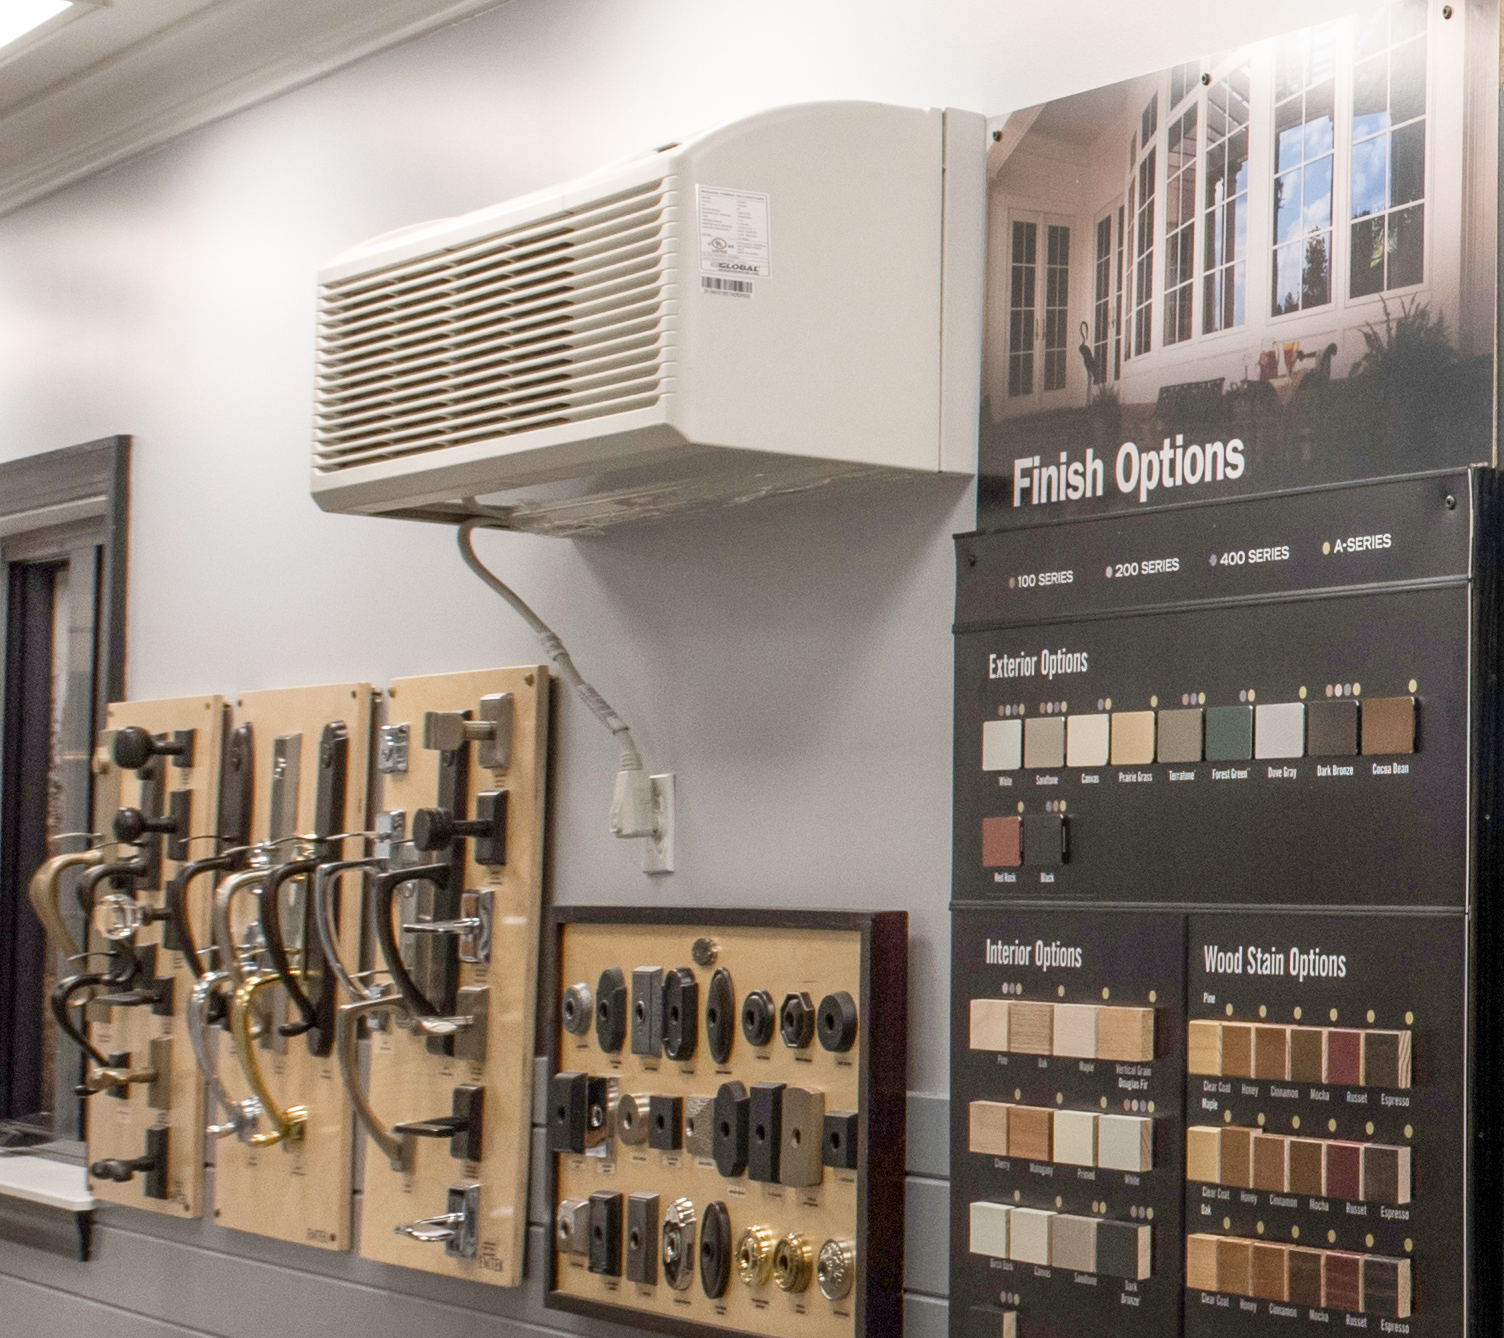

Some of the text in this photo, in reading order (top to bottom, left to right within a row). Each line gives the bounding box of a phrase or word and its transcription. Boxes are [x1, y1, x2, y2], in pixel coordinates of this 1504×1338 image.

[1014, 434, 1245, 507] Finish Options
[1220, 546, 1289, 565] 400 SERIES
[1115, 558, 1179, 577] 200 SERIES
[1018, 570, 1073, 587] 100 SERIES
[989, 648, 1088, 679] Exterior Options
[1212, 769, 1230, 779] Forest
[1317, 765, 1353, 776] Dark Bronze
[1372, 763, 1409, 775] Cocoa Bean
[1119, 771, 1152, 782] Prairie Grass
[986, 939, 1082, 972] Interior Options
[1204, 945, 1346, 982] Wood Stain Options
[1203, 992, 1215, 1004] Pine
[1203, 1080, 1231, 1093] Clear Coat
[1242, 1084, 1258, 1097] Honey
[1271, 1086, 1298, 1098] Cinnamon
[1310, 1089, 1330, 1101] Mocha
[1346, 1091, 1367, 1103] Russet
[1381, 1093, 1410, 1107] Espresso
[1202, 1098, 1218, 1111] Maple
[1346, 1202, 1367, 1215] Russet
[1381, 1206, 1409, 1220] Espresso
[1381, 1319, 1409, 1334] Espresso
